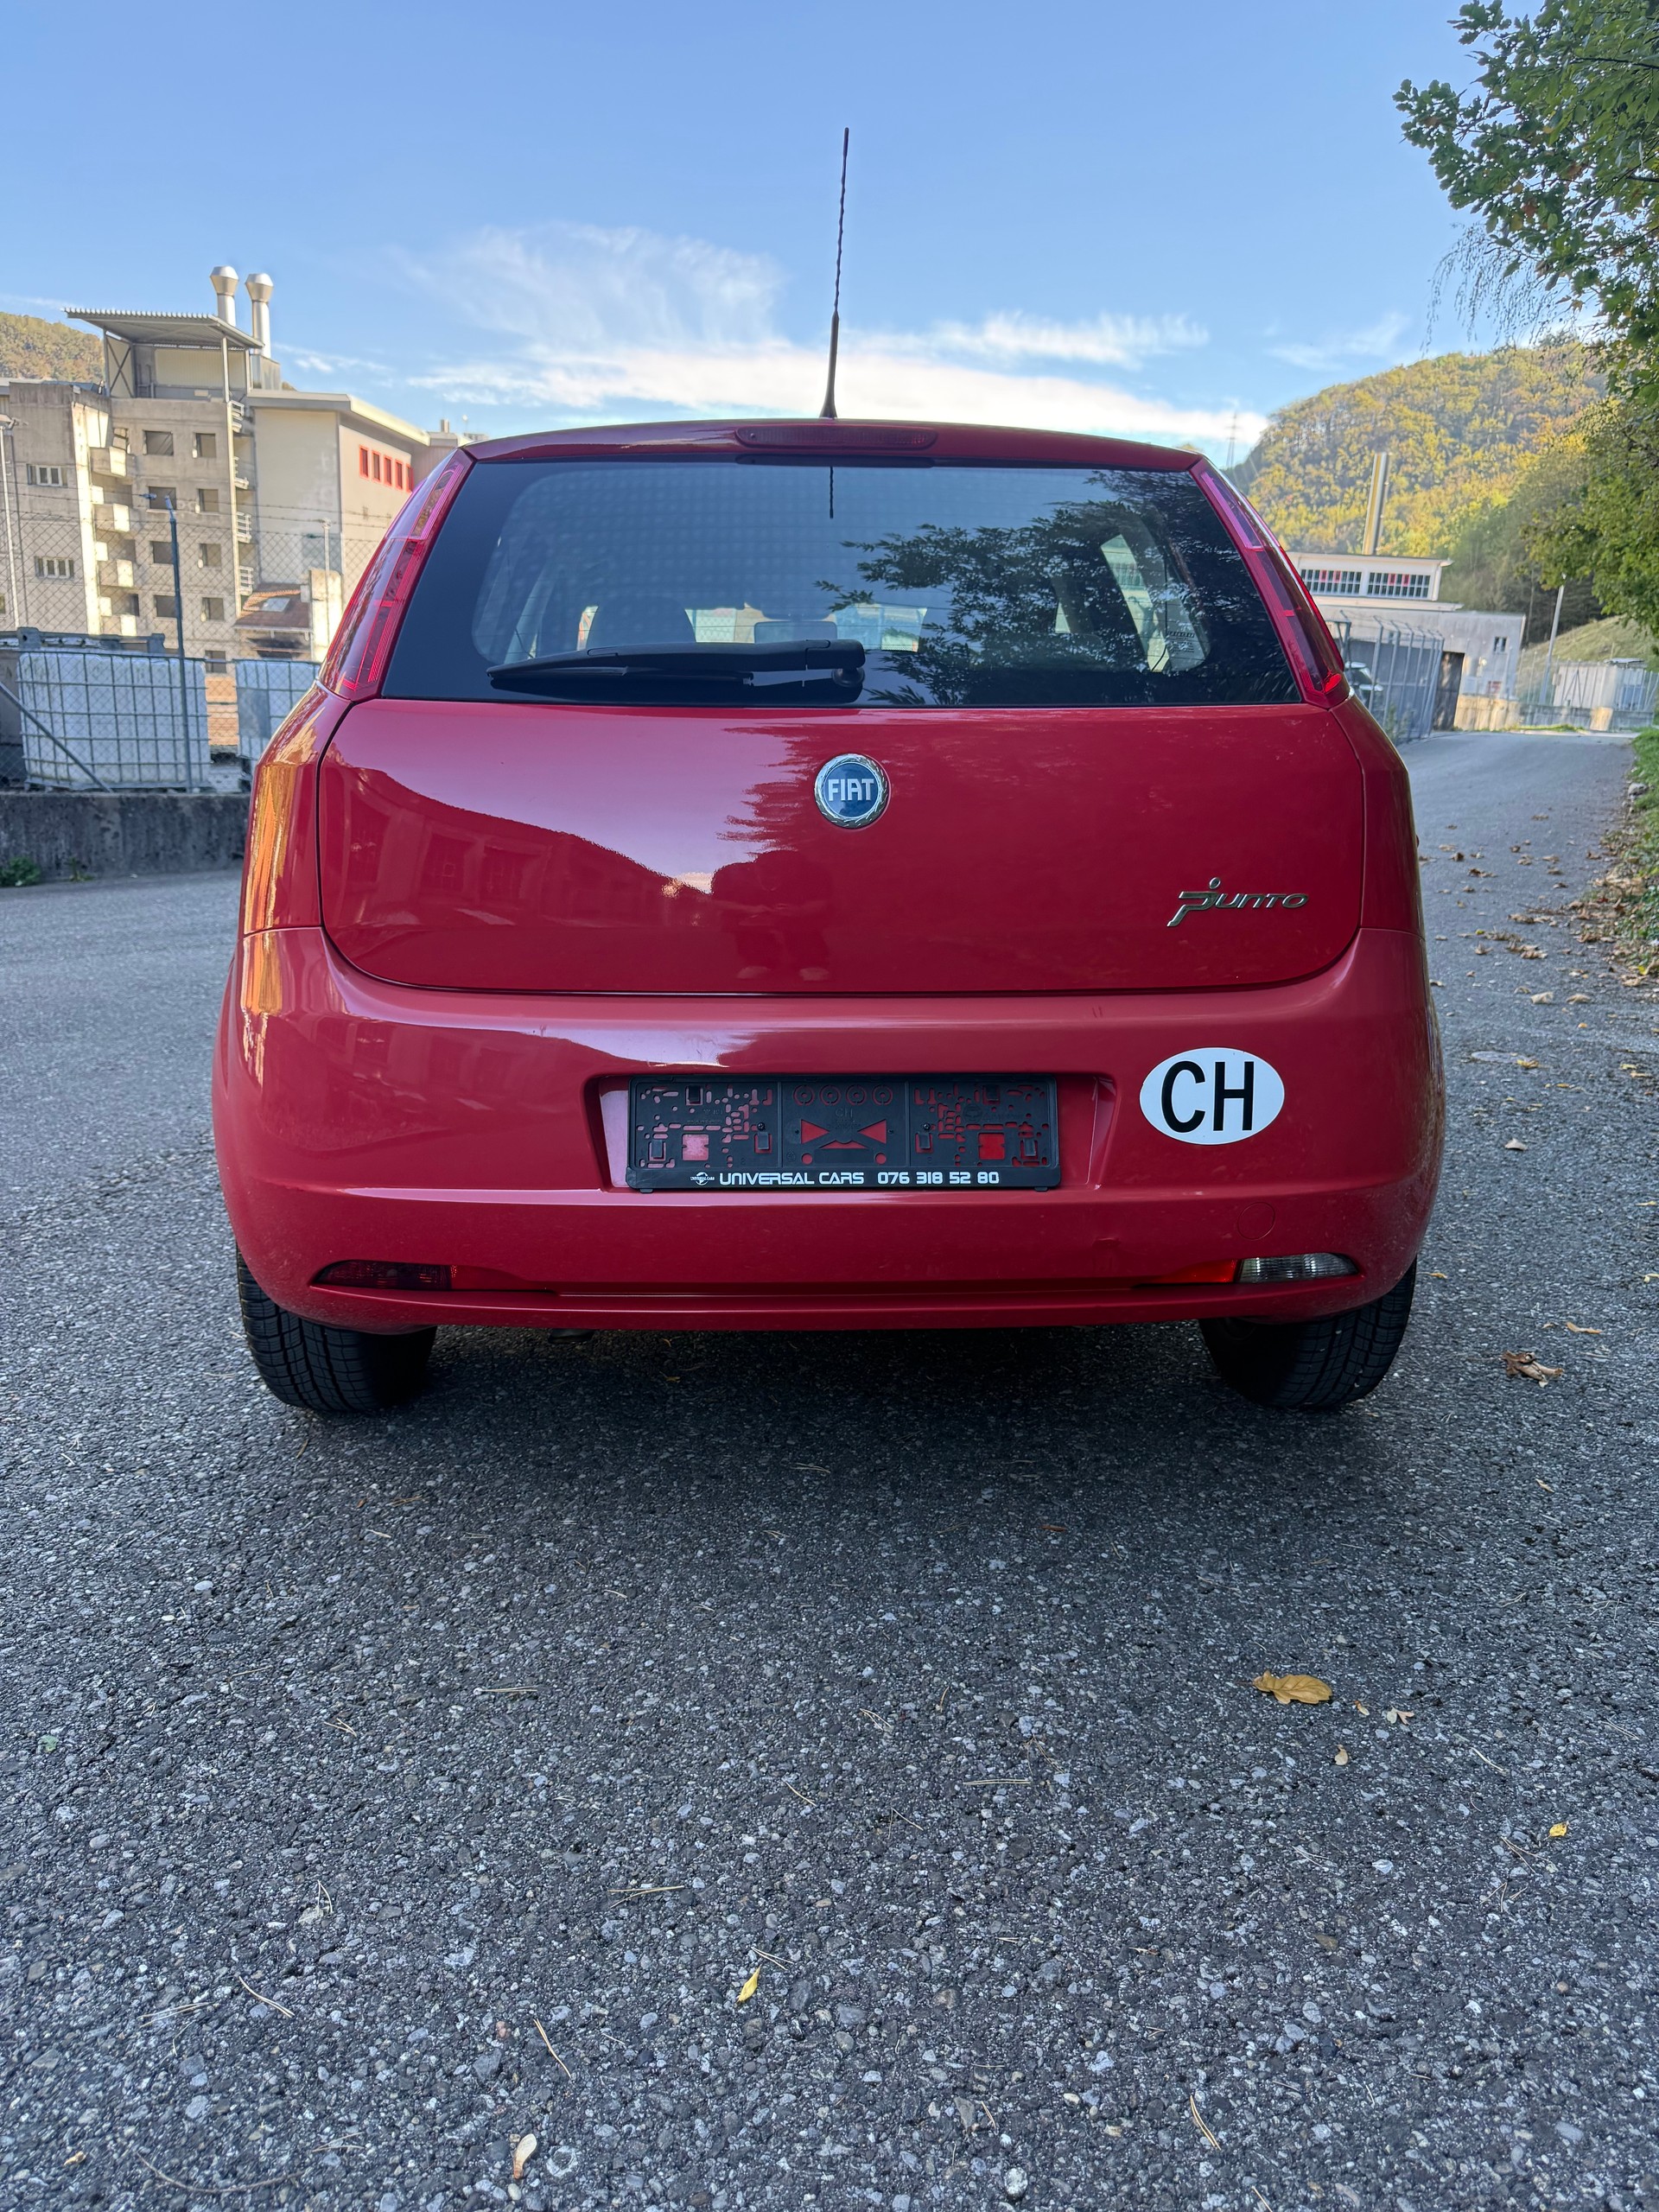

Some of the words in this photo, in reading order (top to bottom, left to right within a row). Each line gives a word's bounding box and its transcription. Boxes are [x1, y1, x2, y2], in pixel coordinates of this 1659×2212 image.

[828, 779, 874, 801] FIAT
[1161, 1060, 1254, 1133] CH
[719, 1172, 815, 1185] UNIVERSAL
[818, 1172, 864, 1185] CARS
[877, 1172, 910, 1185] 076
[916, 1172, 944, 1185] 318
[949, 1171, 972, 1185] 52
[977, 1171, 1000, 1185] 80
